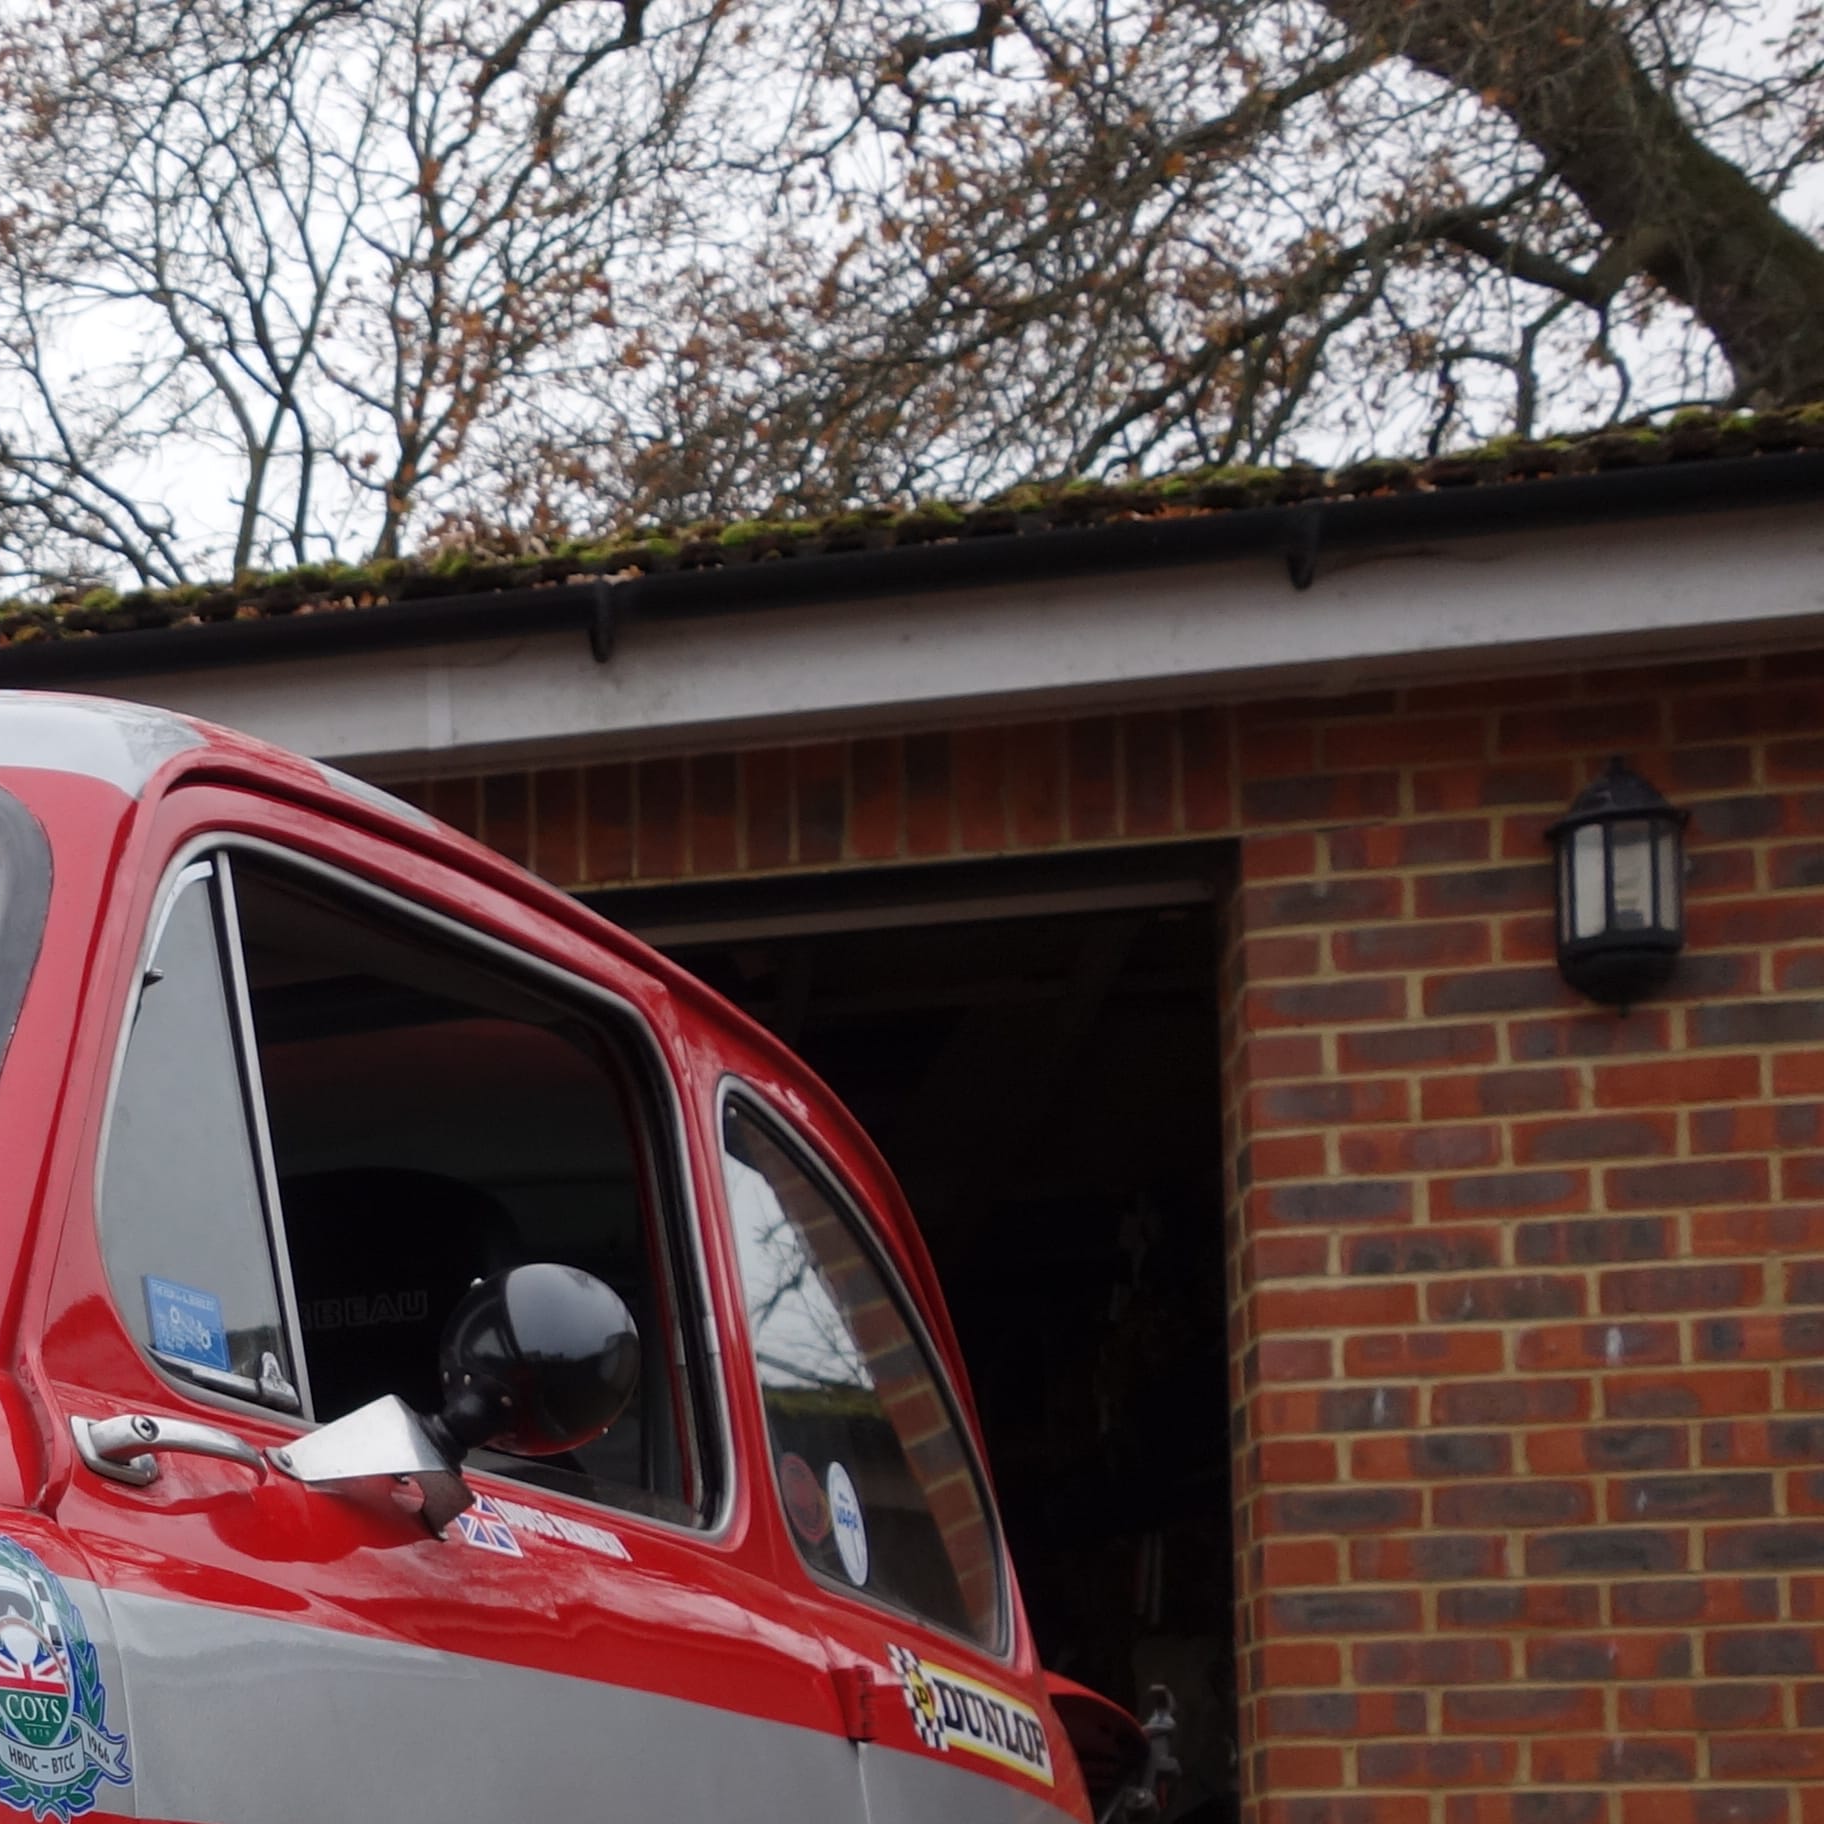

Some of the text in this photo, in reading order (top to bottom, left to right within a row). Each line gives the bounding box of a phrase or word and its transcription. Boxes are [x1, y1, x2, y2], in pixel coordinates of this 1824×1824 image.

[6, 1693, 63, 1724] COYS
[932, 1676, 1047, 1768] DUNLOP
[8, 1745, 39, 1773] HRDC
[52, 1752, 77, 1774] BTCC
[87, 1731, 111, 1765] 1966
